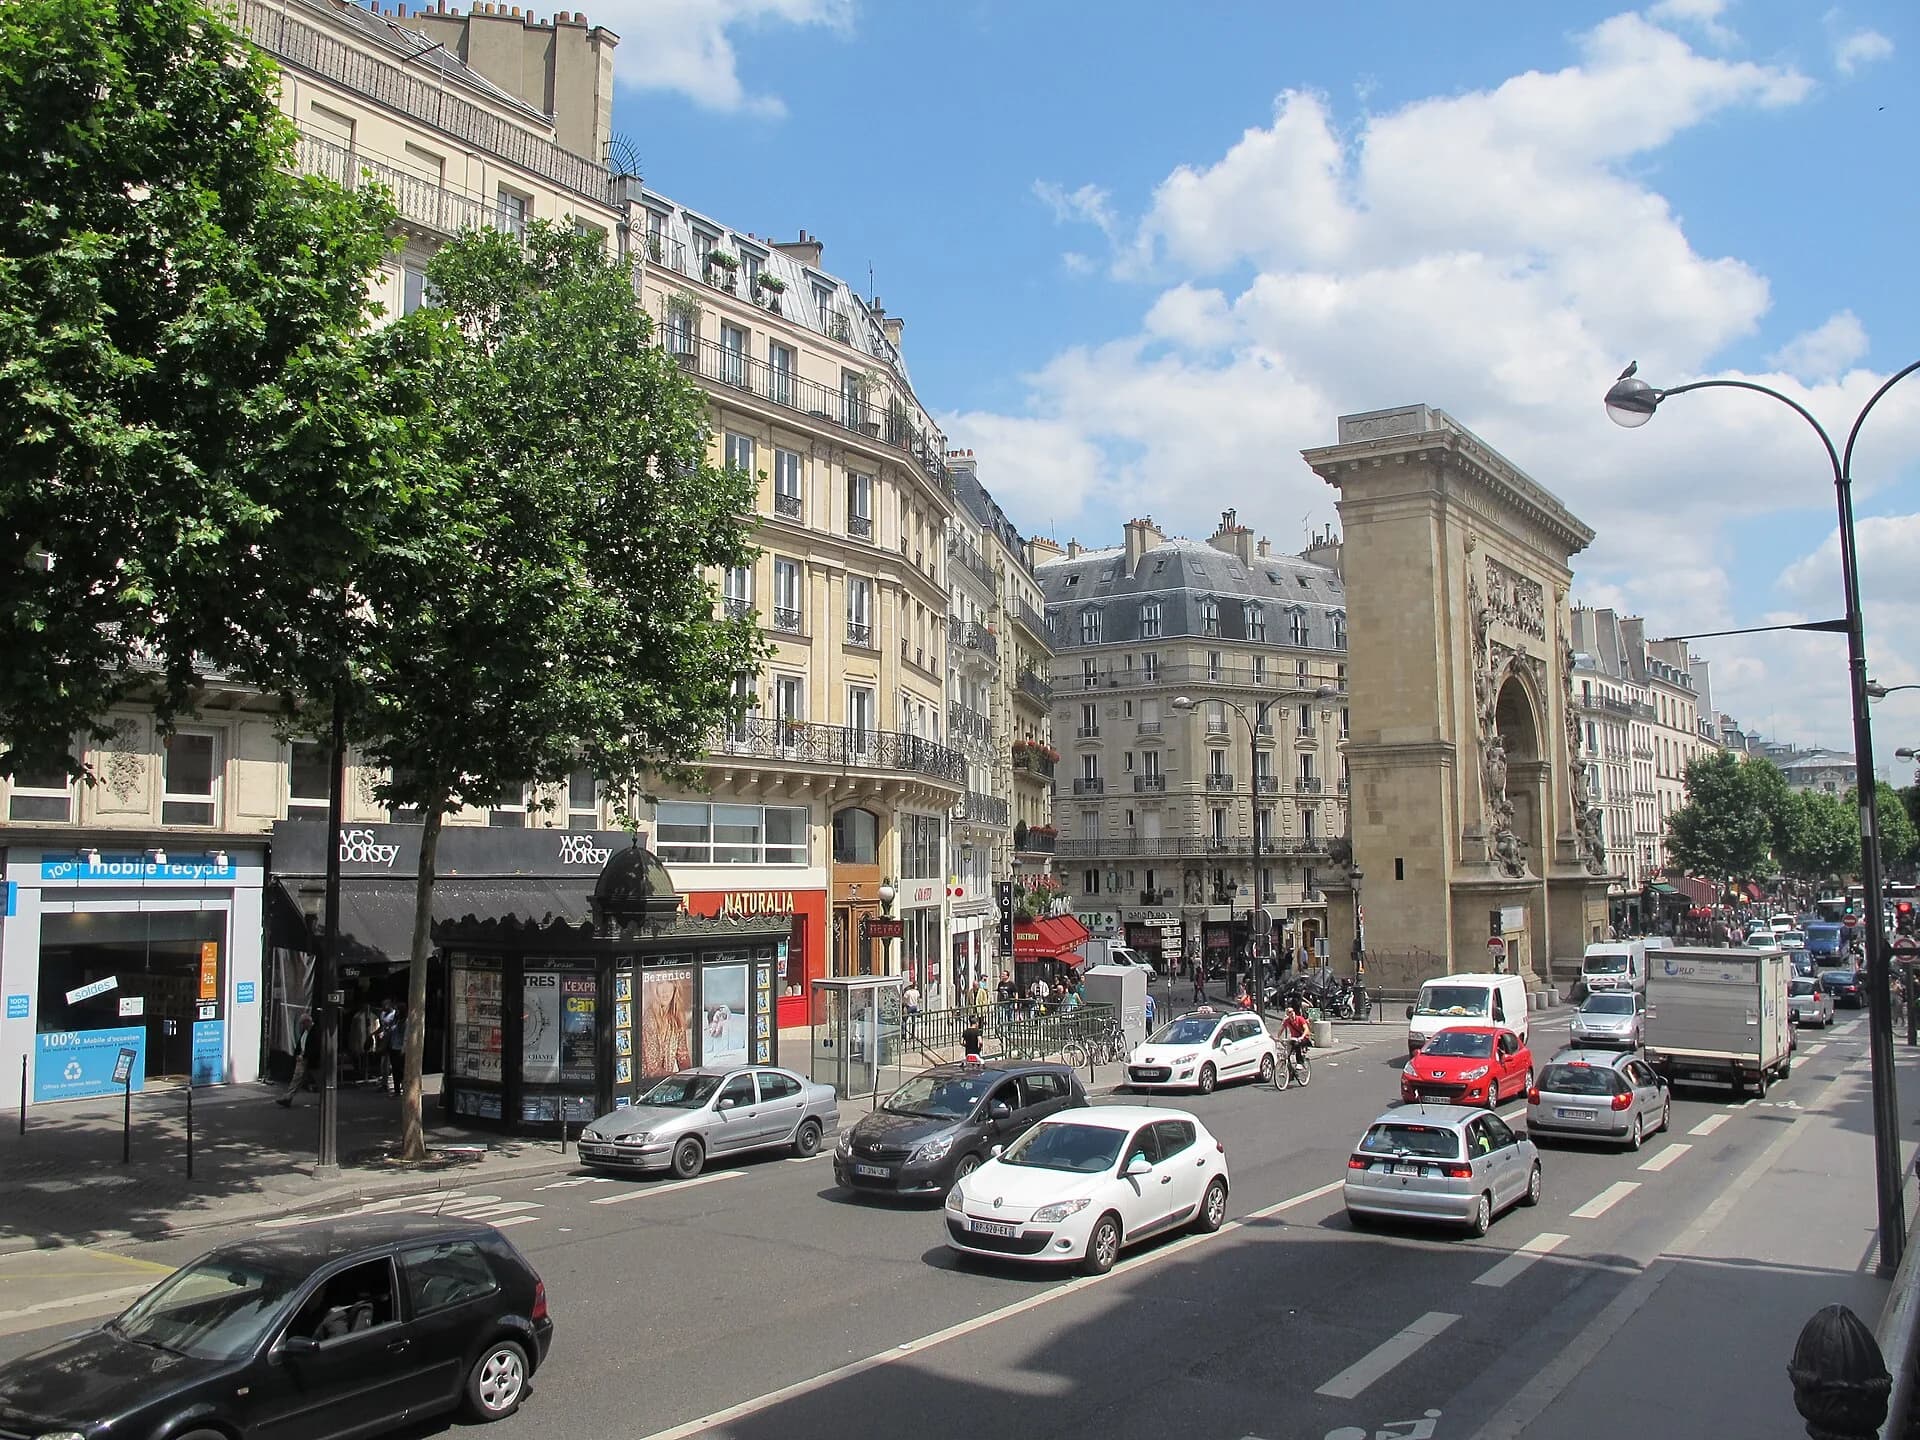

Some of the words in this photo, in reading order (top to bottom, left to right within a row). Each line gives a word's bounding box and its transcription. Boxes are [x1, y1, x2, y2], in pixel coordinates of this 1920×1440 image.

[48, 859, 82, 879] 100%
[89, 857, 157, 875] mobile
[164, 862, 228, 878] recycle
[724, 892, 794, 914] NATURALIA
[74, 980, 111, 1001] soldes
[566, 997, 594, 1013] Can
[43, 1031, 81, 1047] 100%
